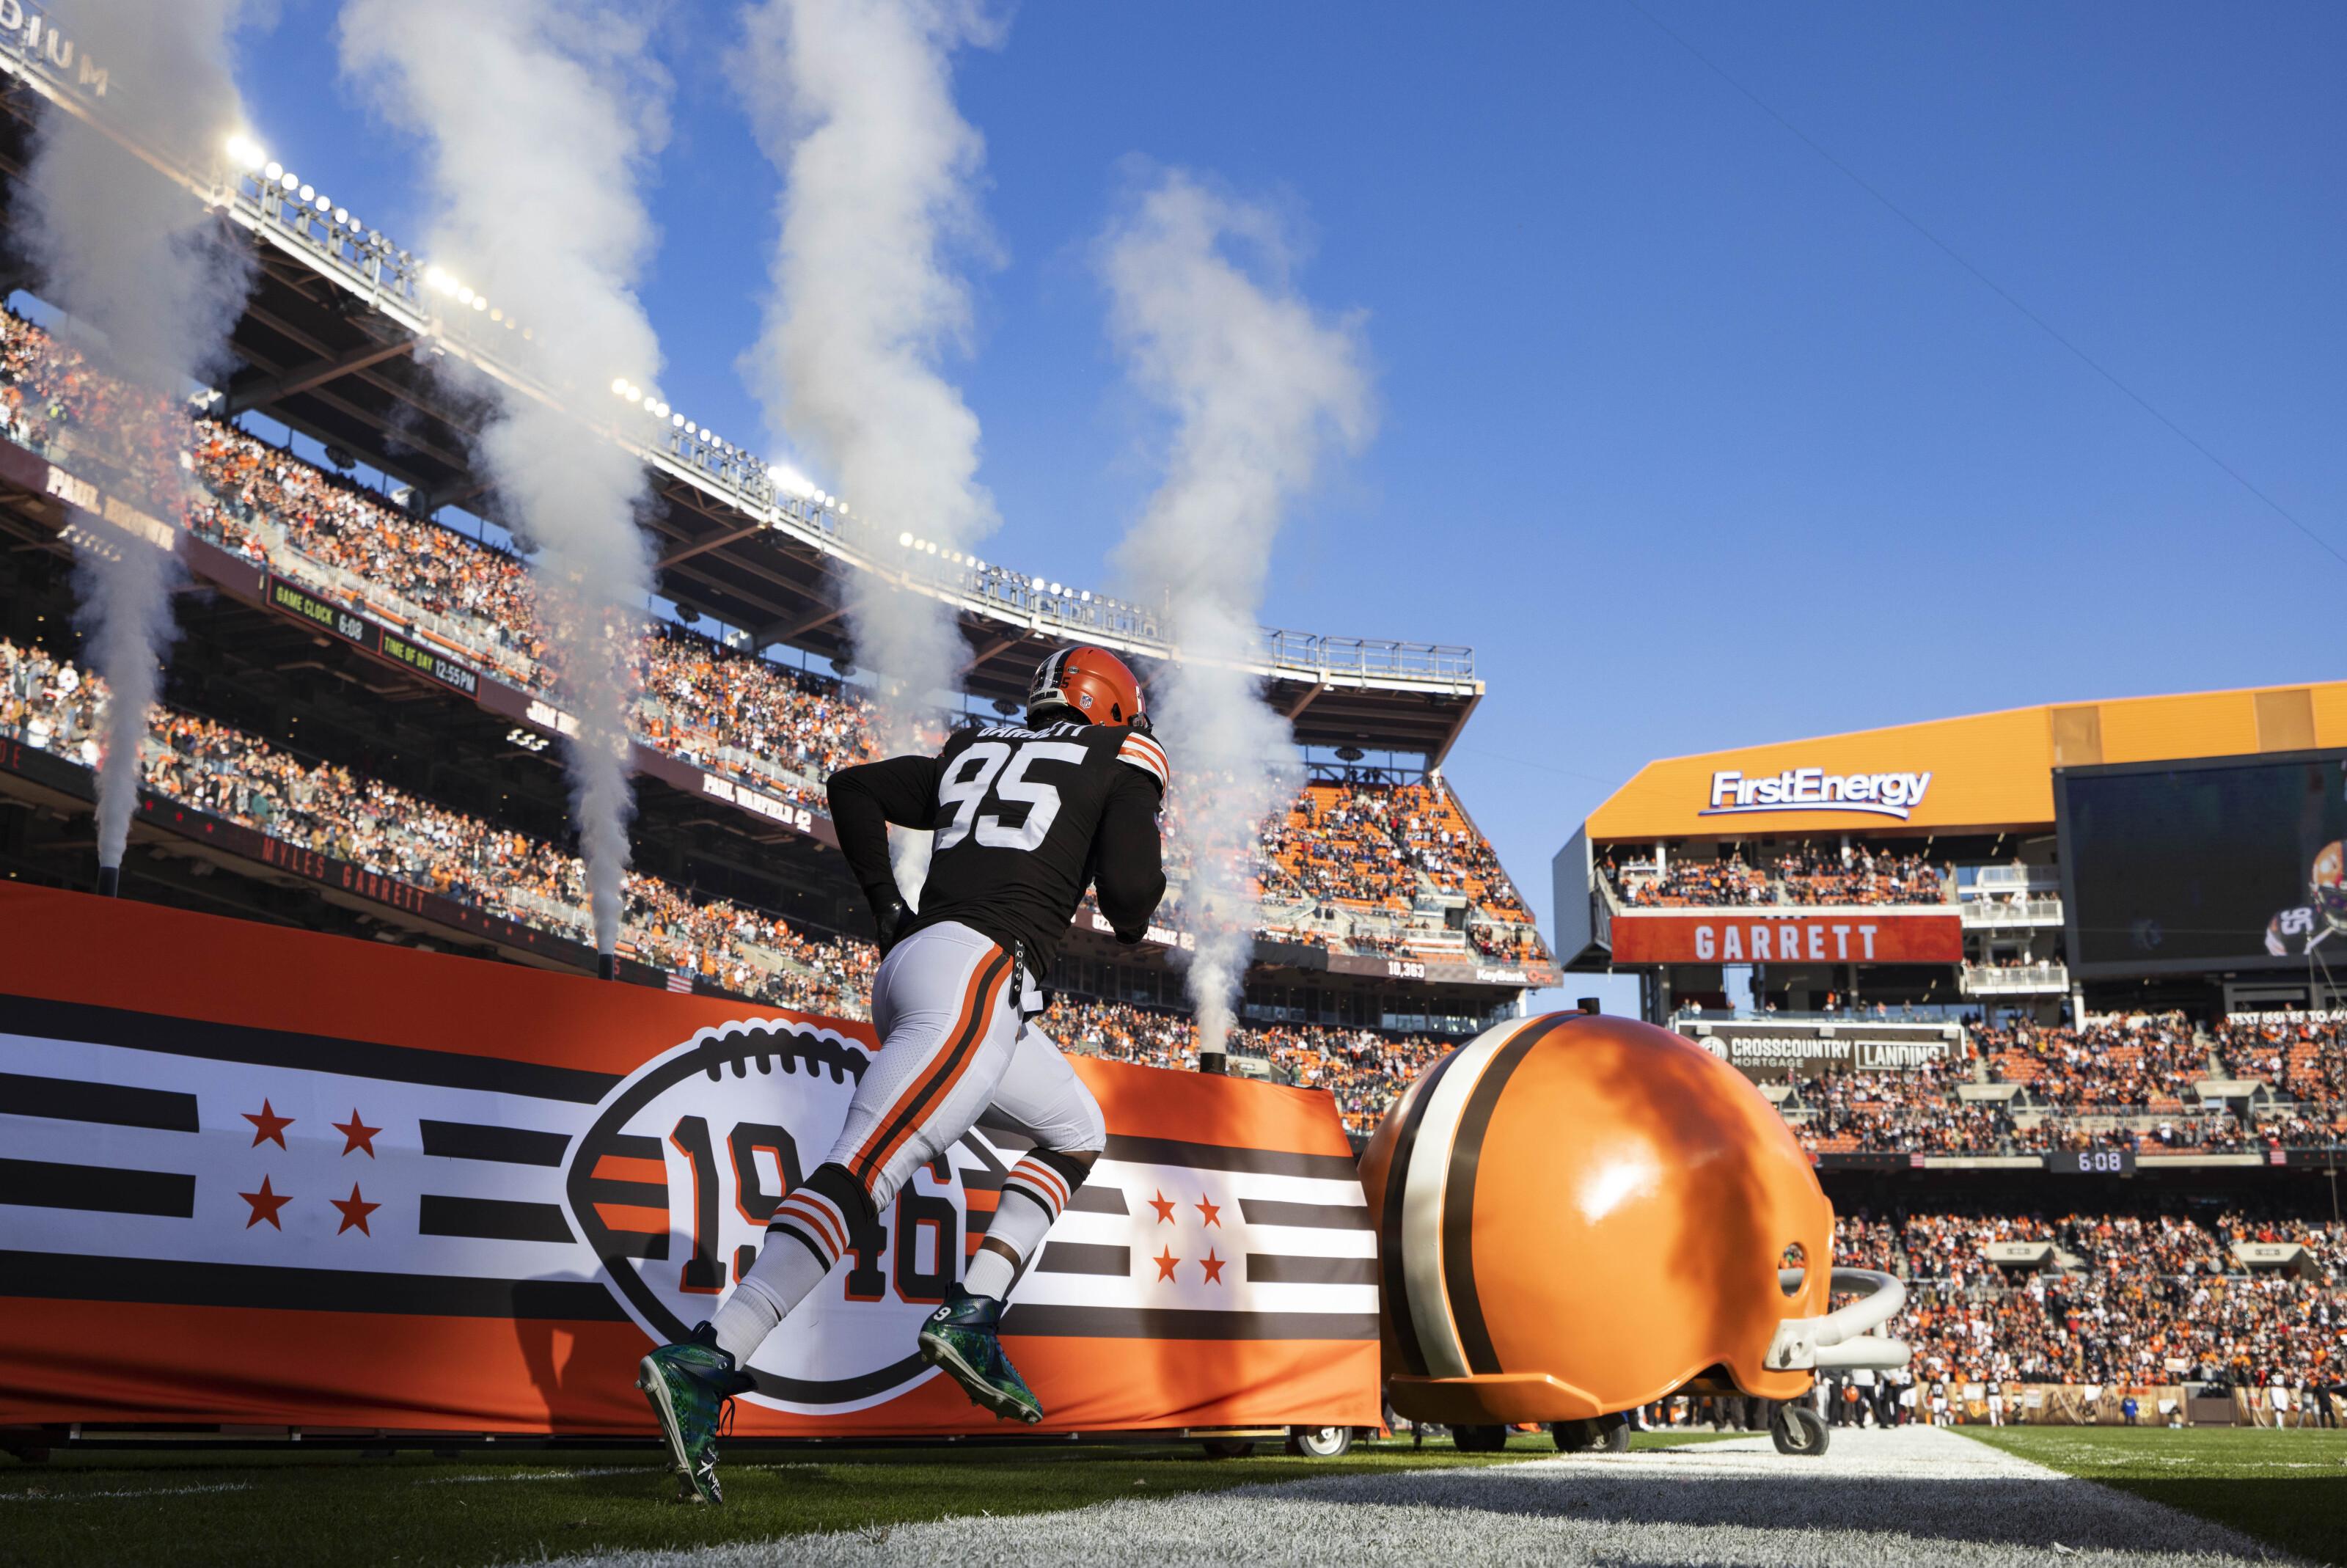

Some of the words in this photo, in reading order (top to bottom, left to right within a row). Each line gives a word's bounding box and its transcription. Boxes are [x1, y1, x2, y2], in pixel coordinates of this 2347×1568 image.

[276, 586, 301, 611] GAME
[304, 599, 333, 625] CLOCK
[338, 613, 363, 641] 6:08
[384, 636, 404, 659] TIME
[405, 646, 417, 662] OF
[417, 651, 433, 671] DAY
[435, 660, 461, 686] 12:55
[461, 670, 476, 693] PM
[931, 741, 1090, 851] 95
[1710, 766, 1933, 808] FirstEnergy
[703, 773, 736, 802] PAUL
[794, 809, 812, 833] 42
[263, 836, 325, 879] MYLES
[343, 865, 425, 915] GARRETT
[2280, 907, 2314, 935] 95
[1694, 924, 1878, 960] GARRETT
[1388, 961, 1425, 978] 10,363
[1476, 968, 1527, 983] KeyBank
[2307, 1009, 2327, 1023] TO
[1732, 1037, 1852, 1058] CROSSCOUNTRY
[1864, 1045, 1940, 1067] LANDING
[1732, 1057, 1804, 1068] MORTGAGE
[2079, 1152, 2122, 1171] 6:08
[933, 1306, 951, 1321] 9
